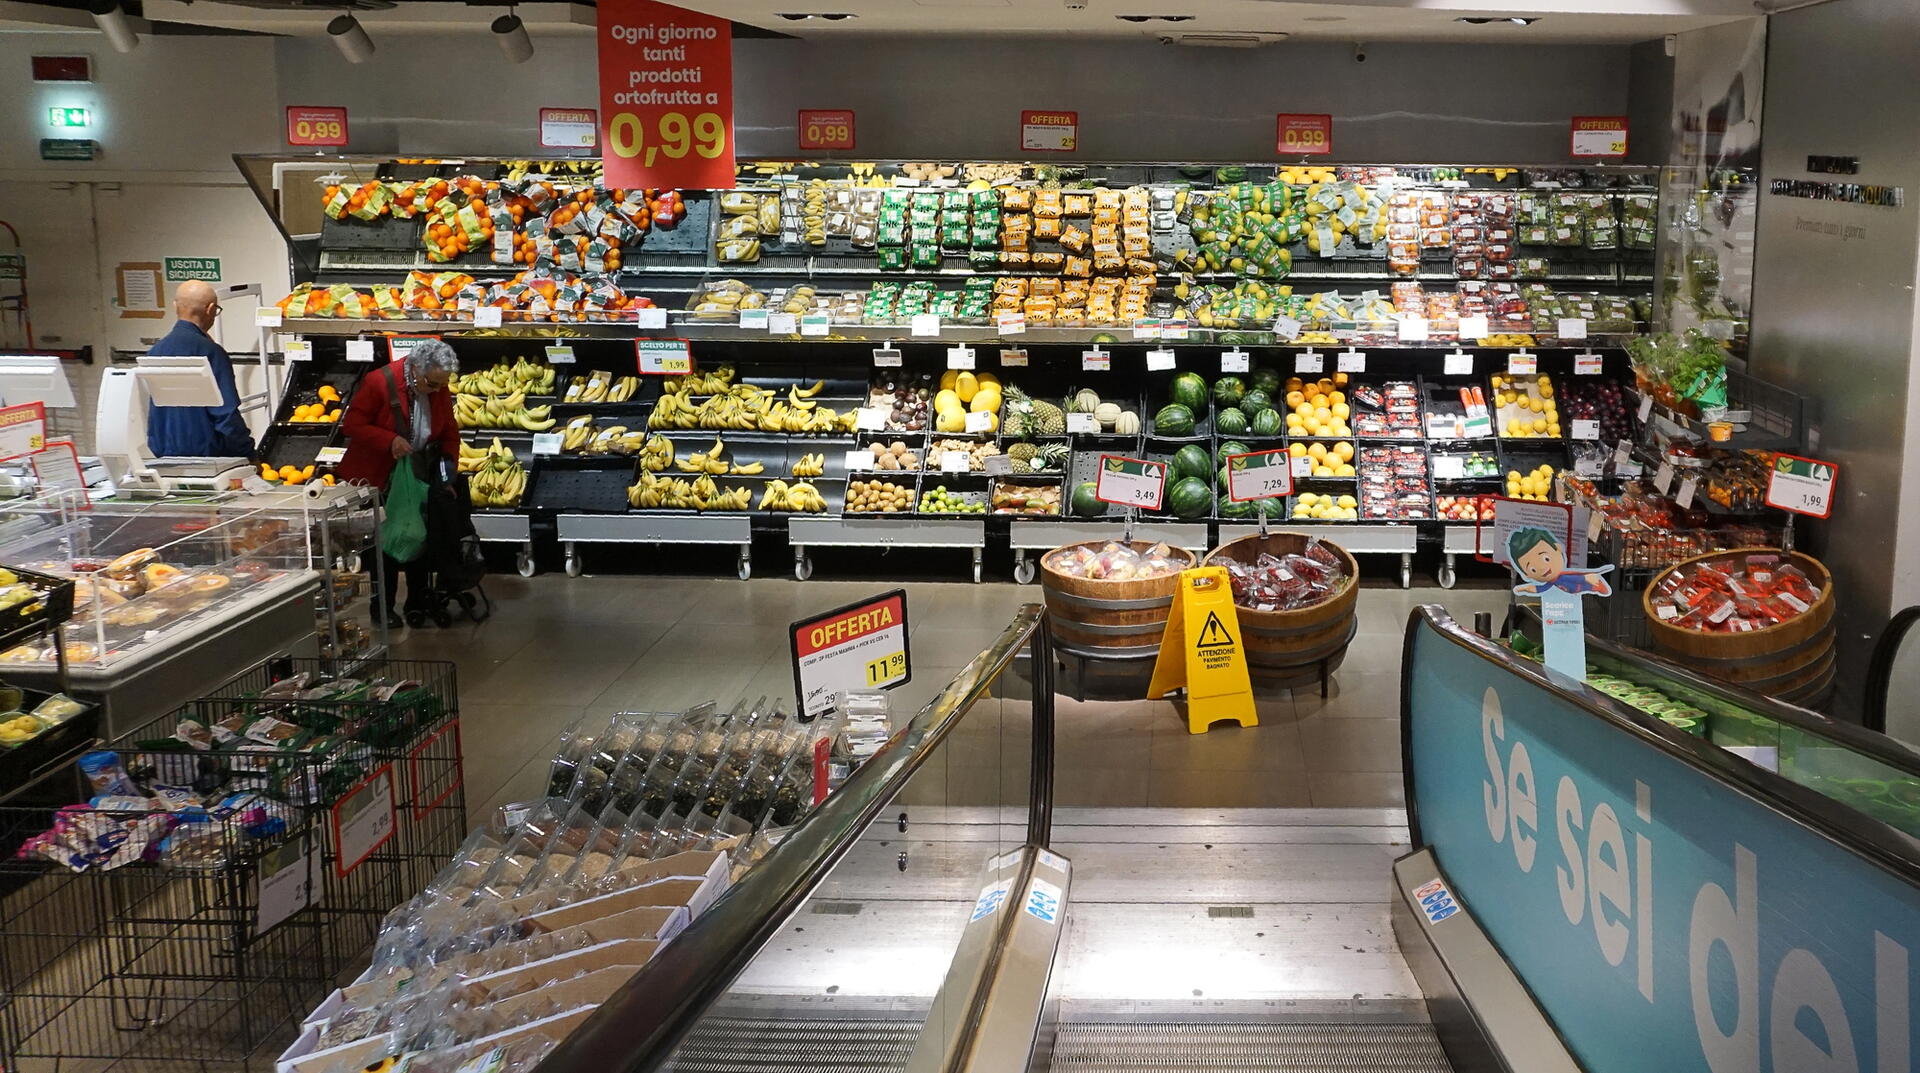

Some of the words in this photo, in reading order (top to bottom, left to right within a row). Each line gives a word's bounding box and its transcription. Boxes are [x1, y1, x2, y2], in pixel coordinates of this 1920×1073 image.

[611, 24, 654, 45] Ogni
[658, 23, 717, 44] giorno
[643, 45, 685, 61] tanti
[629, 66, 701, 87] prodotti
[614, 88, 702, 104] ortofrutta
[705, 92, 718, 104] a
[548, 112, 591, 122] OFFERTA
[1031, 115, 1072, 124] OFFERTA
[1580, 121, 1621, 129] OFFERTA
[296, 121, 341, 140] 0,99
[807, 125, 849, 144] 0,99
[610, 112, 725, 167] 0,99
[1285, 130, 1324, 149] 0,99
[170, 260, 203, 269] USCITA
[206, 260, 215, 269] DI
[168, 270, 219, 279] SICUREZZA
[1263, 479, 1282, 490] 7,29
[1135, 489, 1155, 500] 3,49
[1802, 494, 1822, 506] 1,99
[810, 606, 893, 648] OFFERTA
[825, 651, 839, 660] FESTA
[839, 645, 856, 654] MAMMA
[1198, 648, 1236, 657] ATTENZIONE
[372, 812, 388, 836] 2,99
[1482, 686, 1537, 873] Se
[1556, 779, 1654, 1004] sei
